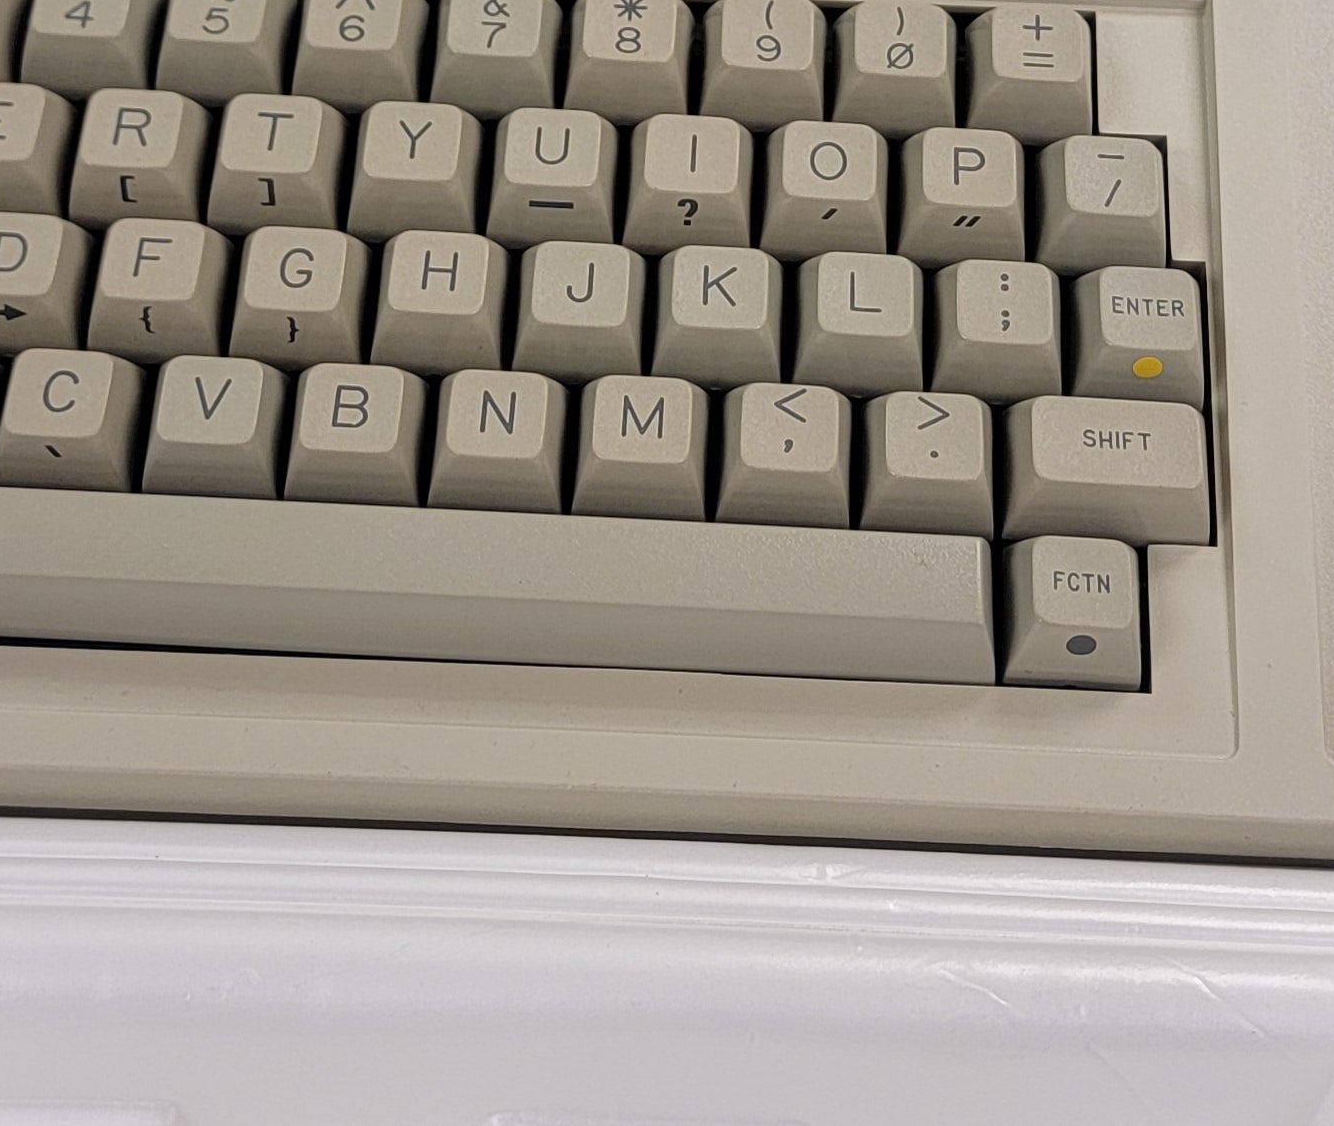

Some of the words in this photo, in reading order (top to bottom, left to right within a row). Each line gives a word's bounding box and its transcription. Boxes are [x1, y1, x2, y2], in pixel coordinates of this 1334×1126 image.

[64, 0, 94, 29] 4
[201, 7, 230, 35] 5
[338, 14, 365, 43] 6
[1022, 14, 1054, 42] +
[481, 21, 507, 49] 7
[614, 26, 642, 54] 8
[755, 34, 782, 62] 9
[1022, 52, 1055, 68] =
[112, 107, 152, 147] R
[257, 111, 295, 152] T
[399, 120, 433, 160] Y
[535, 126, 571, 165] U
[809, 141, 848, 181] O
[953, 146, 986, 186] P
[677, 198, 699, 227] ?
[132, 237, 173, 278] F
[279, 247, 315, 289] G
[421, 249, 459, 292] H
[566, 262, 595, 303] J
[702, 264, 738, 307] K
[849, 271, 883, 313] L
[1111, 295, 1185, 318] ENTER
[42, 370, 80, 413] C
[194, 376, 232, 420] V
[331, 384, 369, 429] B
[479, 390, 517, 435] N
[621, 394, 665, 440] M
[1082, 429, 1152, 451] SHIFT
[1053, 570, 1111, 594] FCTN
